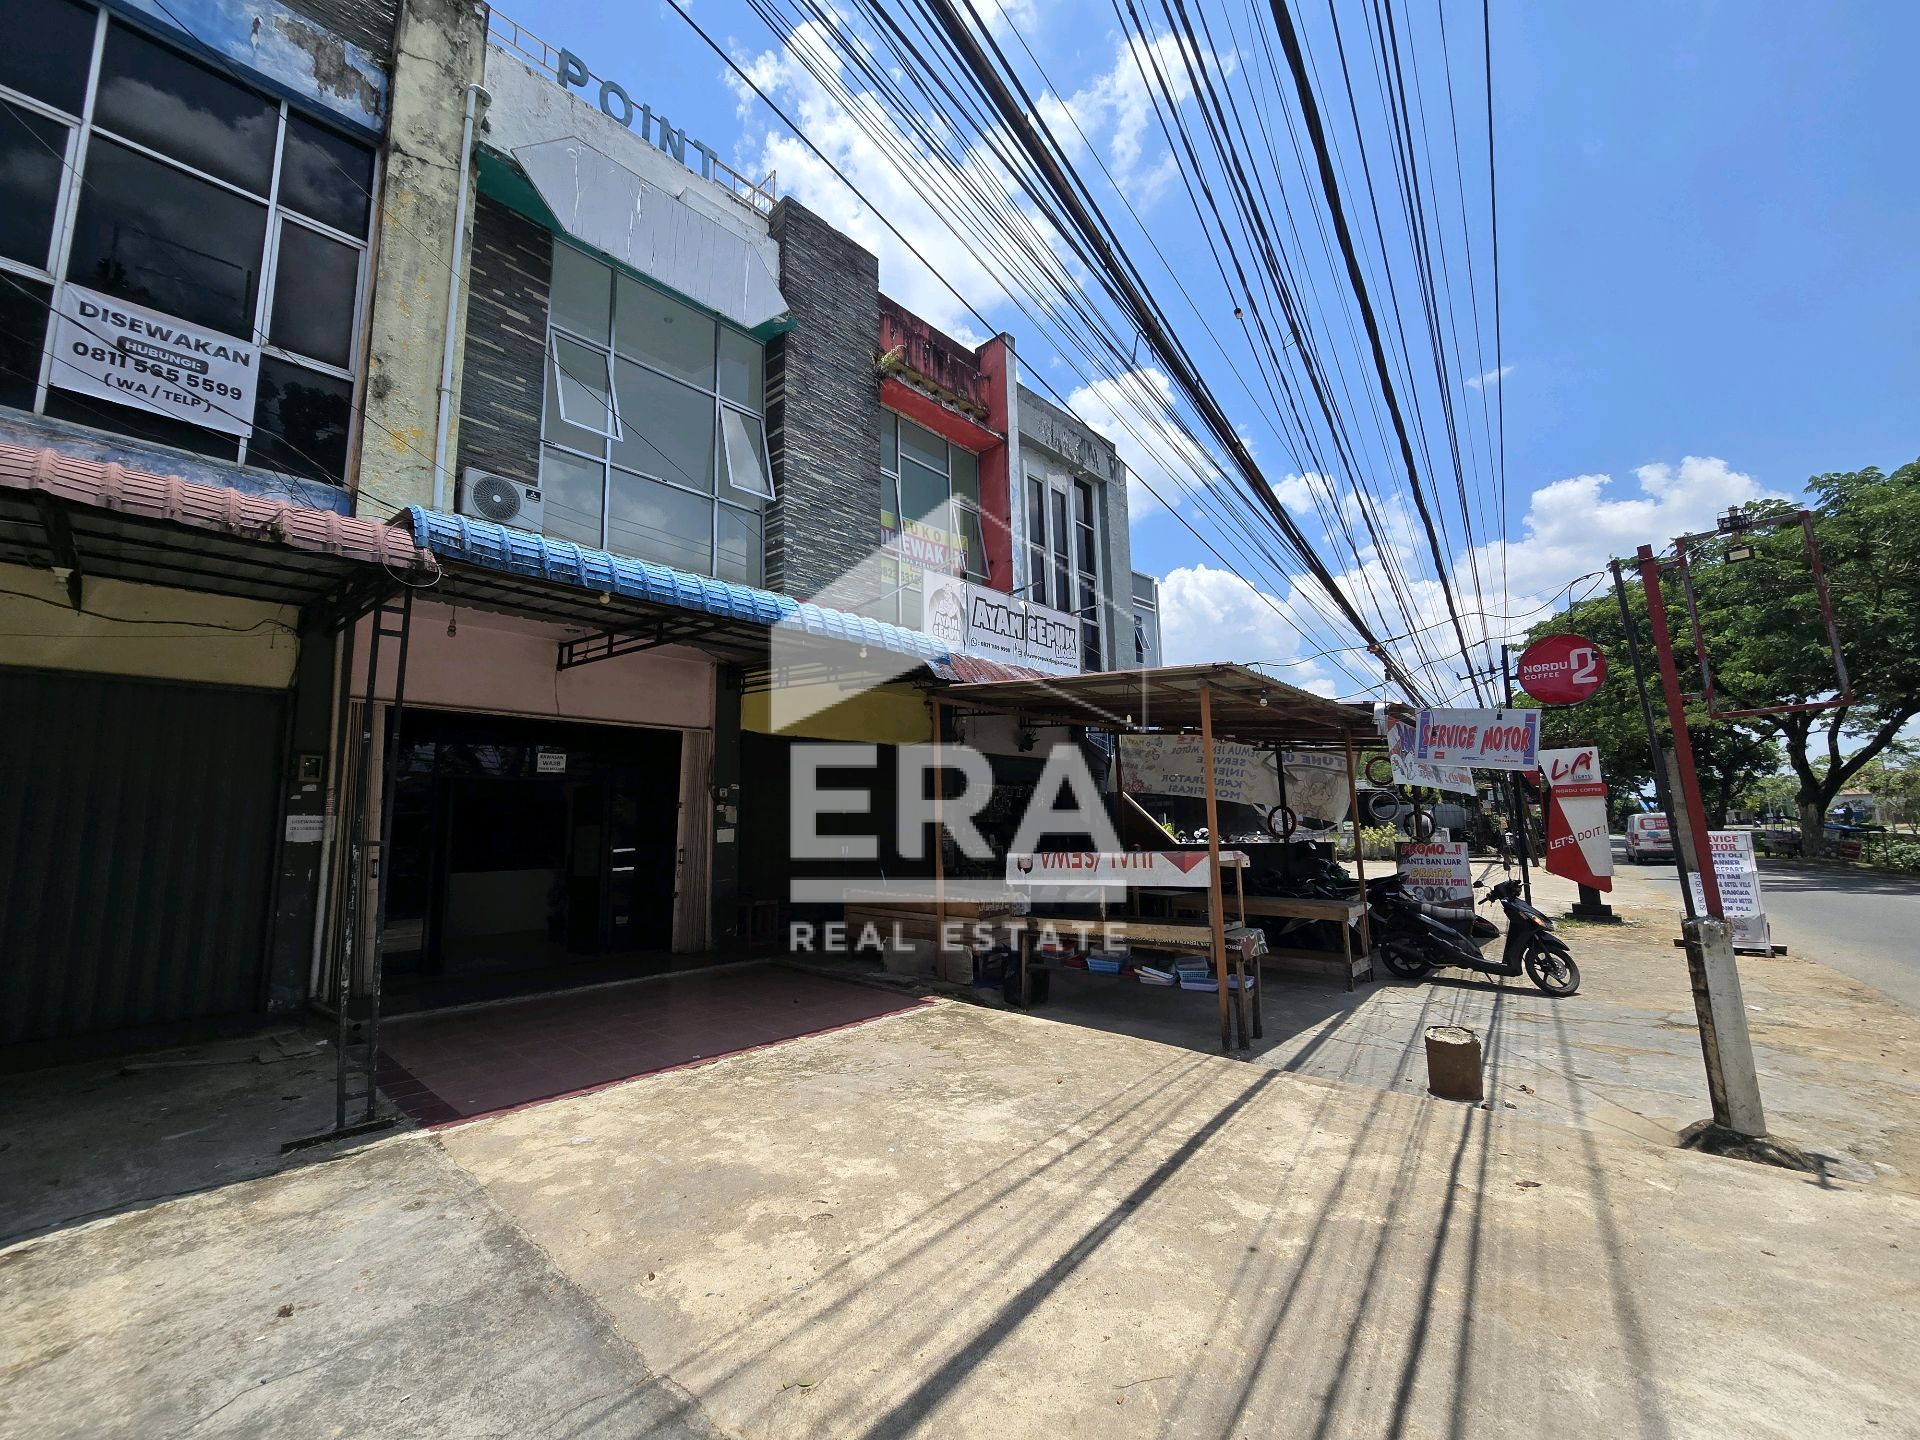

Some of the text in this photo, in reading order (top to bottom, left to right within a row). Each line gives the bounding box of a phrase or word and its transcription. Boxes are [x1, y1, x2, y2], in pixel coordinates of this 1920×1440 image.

[558, 47, 718, 181] POINT
[78, 300, 250, 368] DISEWAKAN
[72, 341, 243, 401] 0811 565 5599
[1028, 614, 1077, 652] GEPUK
[1524, 672, 1560, 680] COFFEE
[1423, 724, 1478, 750] SERVICE
[1480, 726, 1532, 755] MOTOR
[1549, 834, 1576, 850] LET'S
[1411, 868, 1452, 878] GRATIS
[1426, 858, 1442, 866] BAN
[1443, 858, 1462, 866] LUAR
